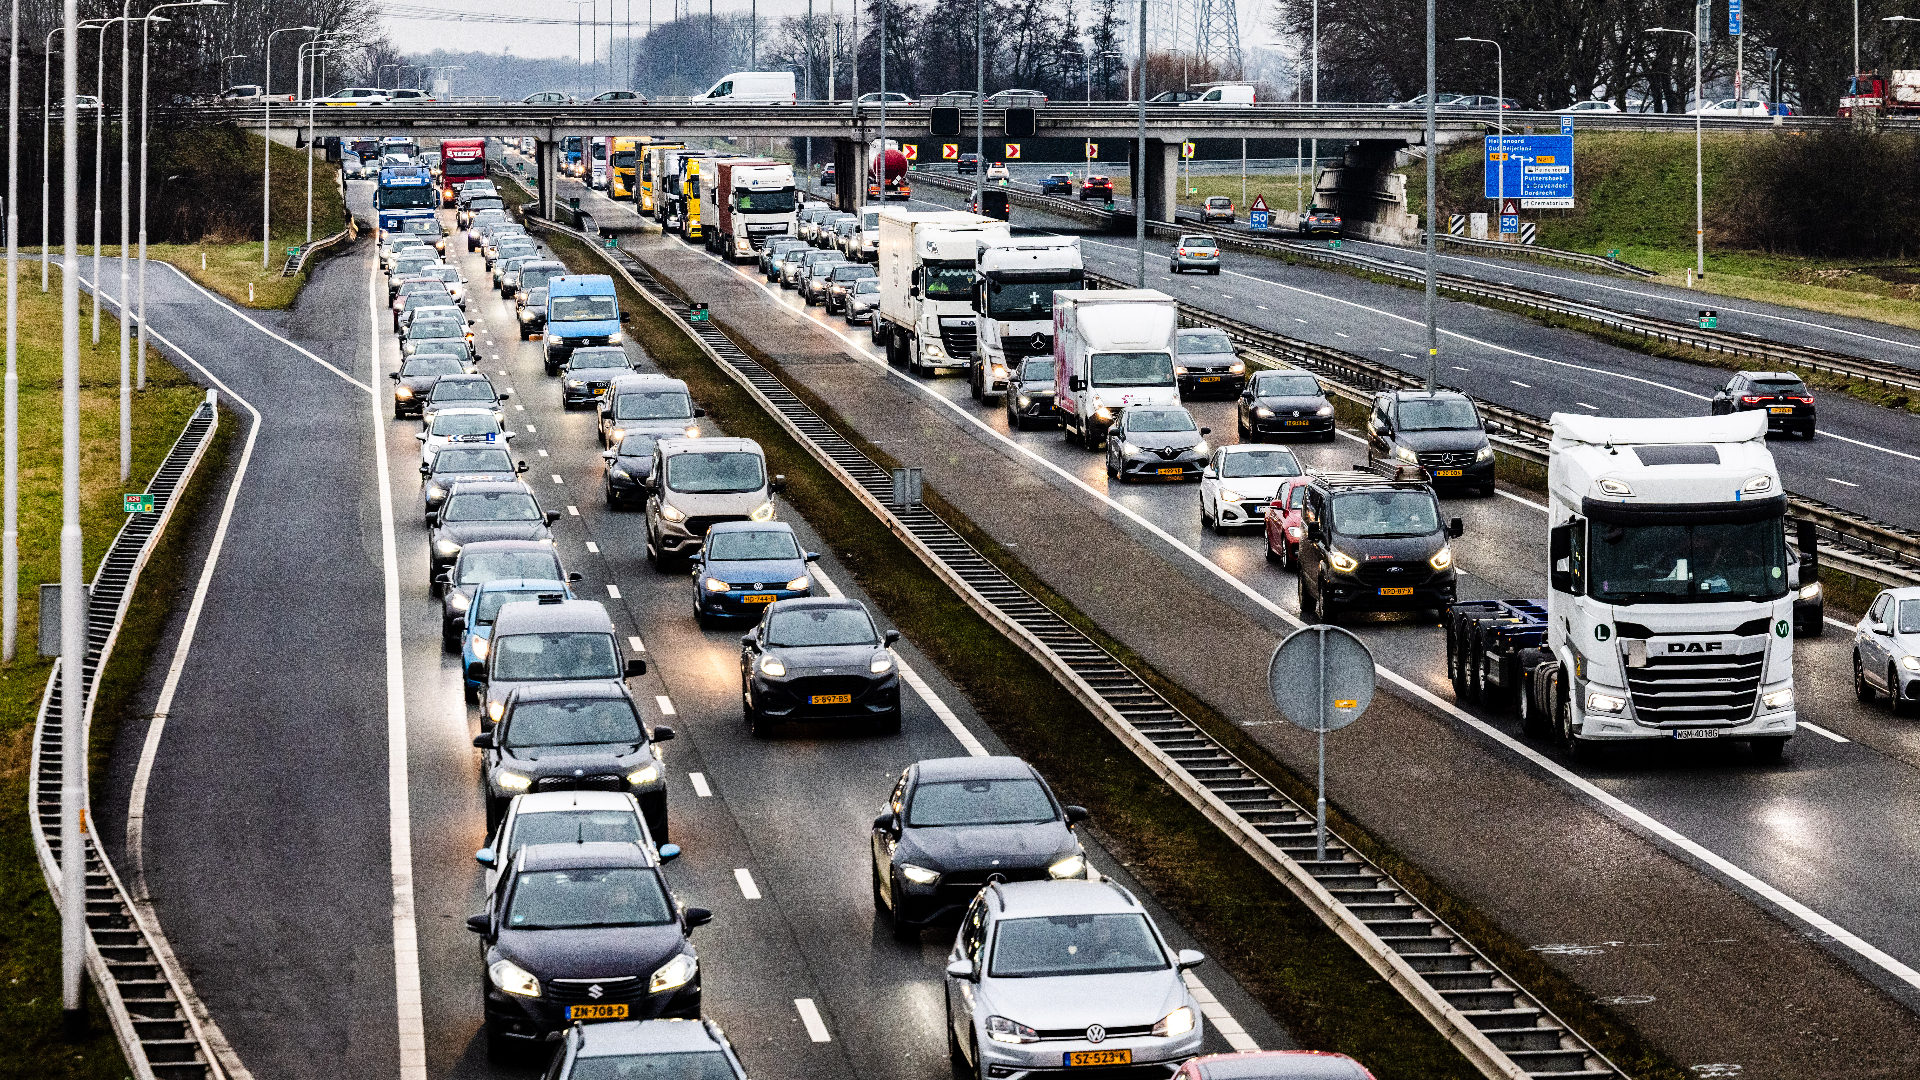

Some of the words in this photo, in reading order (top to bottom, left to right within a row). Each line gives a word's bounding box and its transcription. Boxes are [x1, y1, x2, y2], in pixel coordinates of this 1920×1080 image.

[1252, 213, 1267, 222] 50
[1502, 217, 1517, 227] 50
[1597, 625, 1607, 640] L
[1667, 642, 1722, 653] DAF
[813, 695, 849, 704] S-897-BS
[573, 1005, 625, 1017] ZN-708-D
[1074, 1051, 1127, 1065] SZ-523-K
